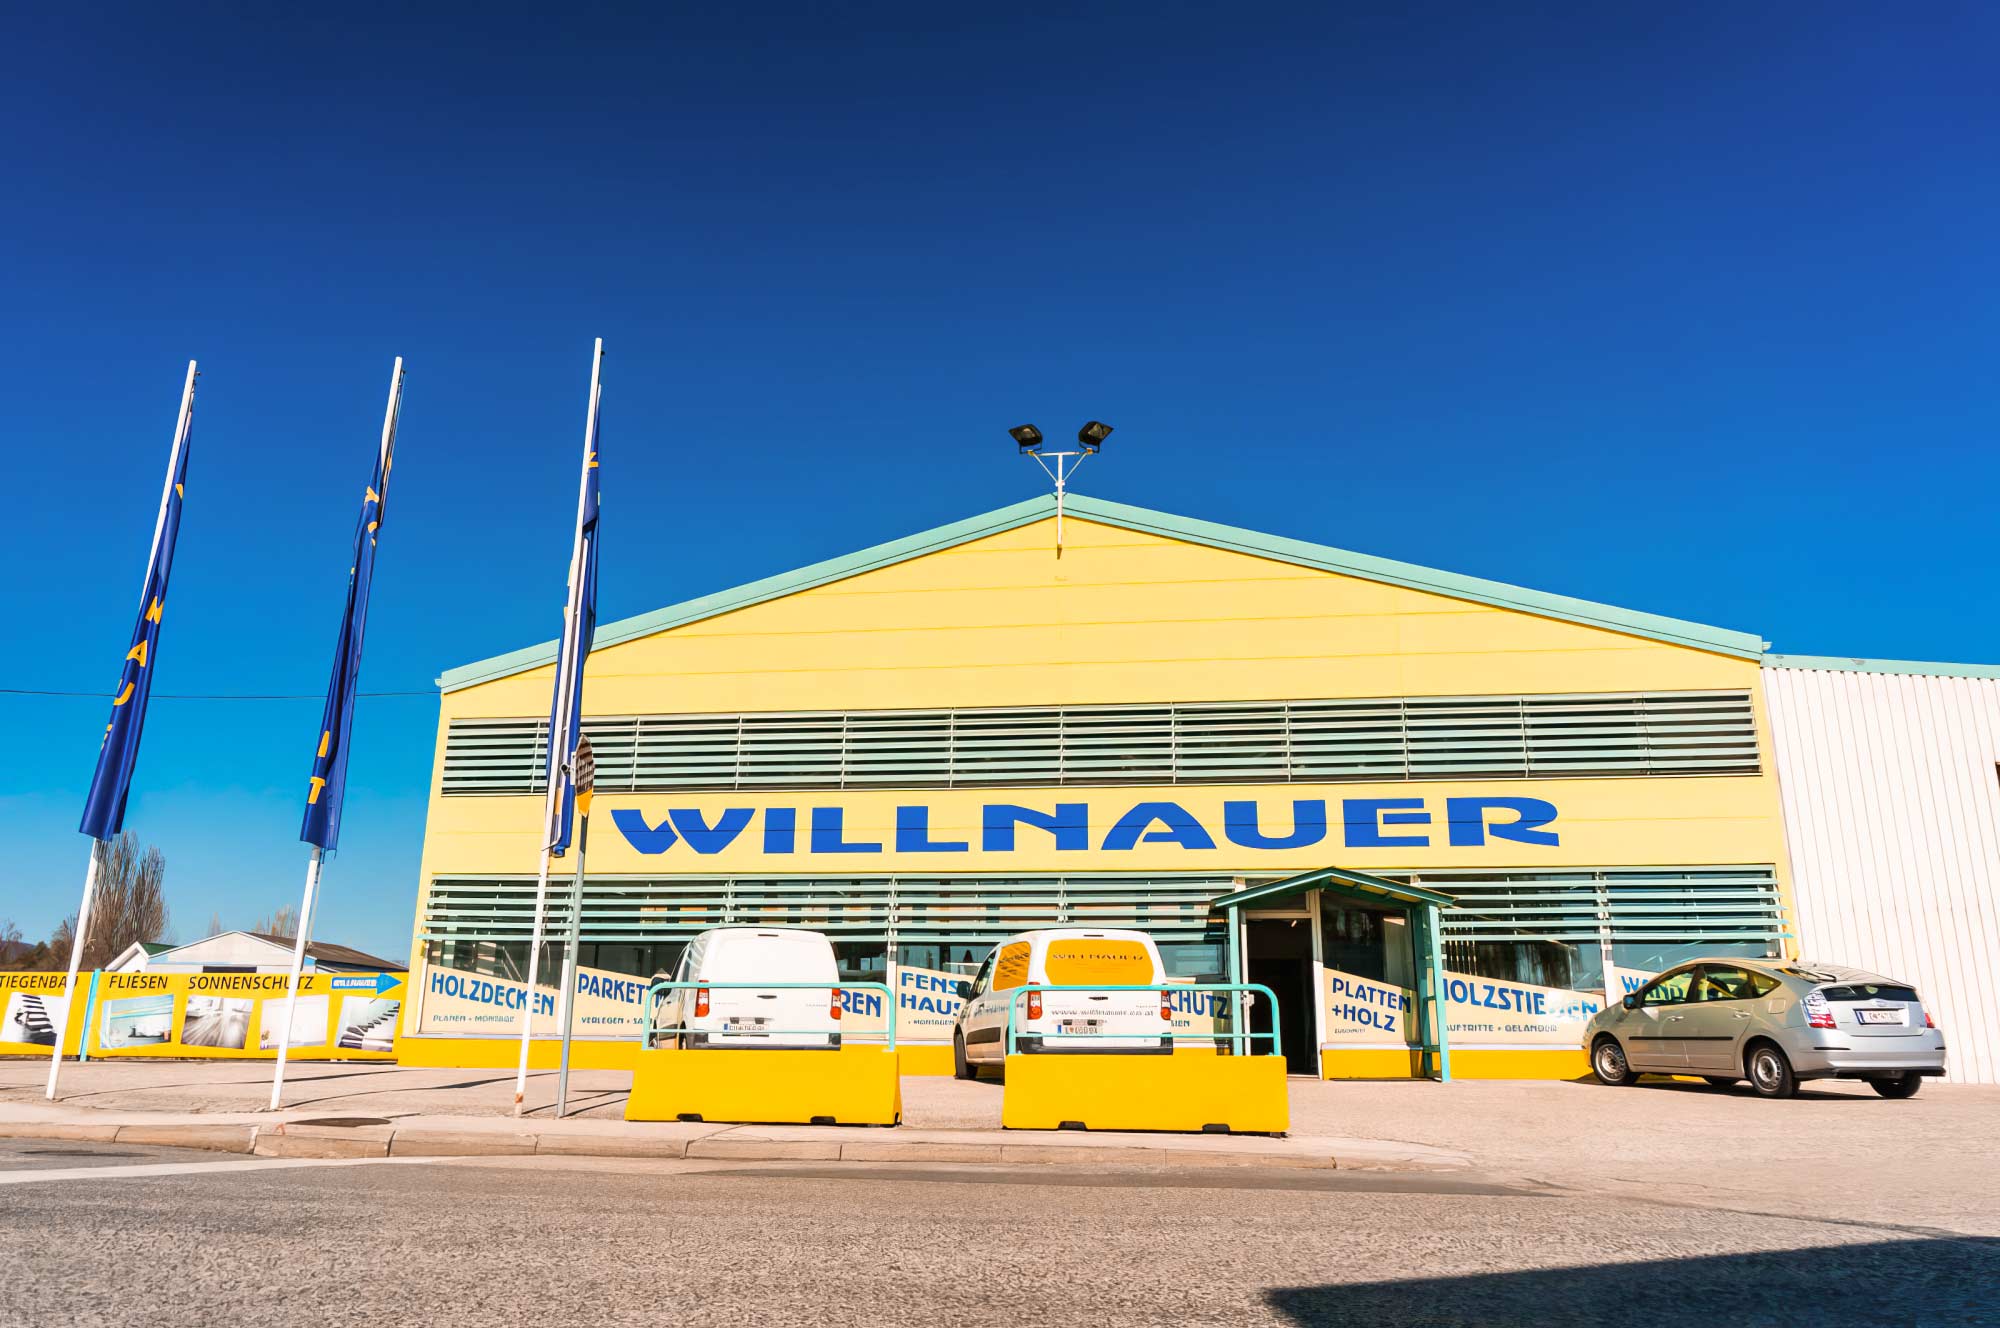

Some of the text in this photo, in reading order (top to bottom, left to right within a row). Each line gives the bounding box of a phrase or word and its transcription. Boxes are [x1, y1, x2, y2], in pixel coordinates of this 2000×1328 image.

[611, 797, 1560, 855] WILLNAUER
[109, 975, 168, 989] FLIESEN
[1332, 977, 1411, 1013] PLATTEN
[840, 989, 881, 1018] REN
[1332, 1003, 1396, 1033] +HOLZ
